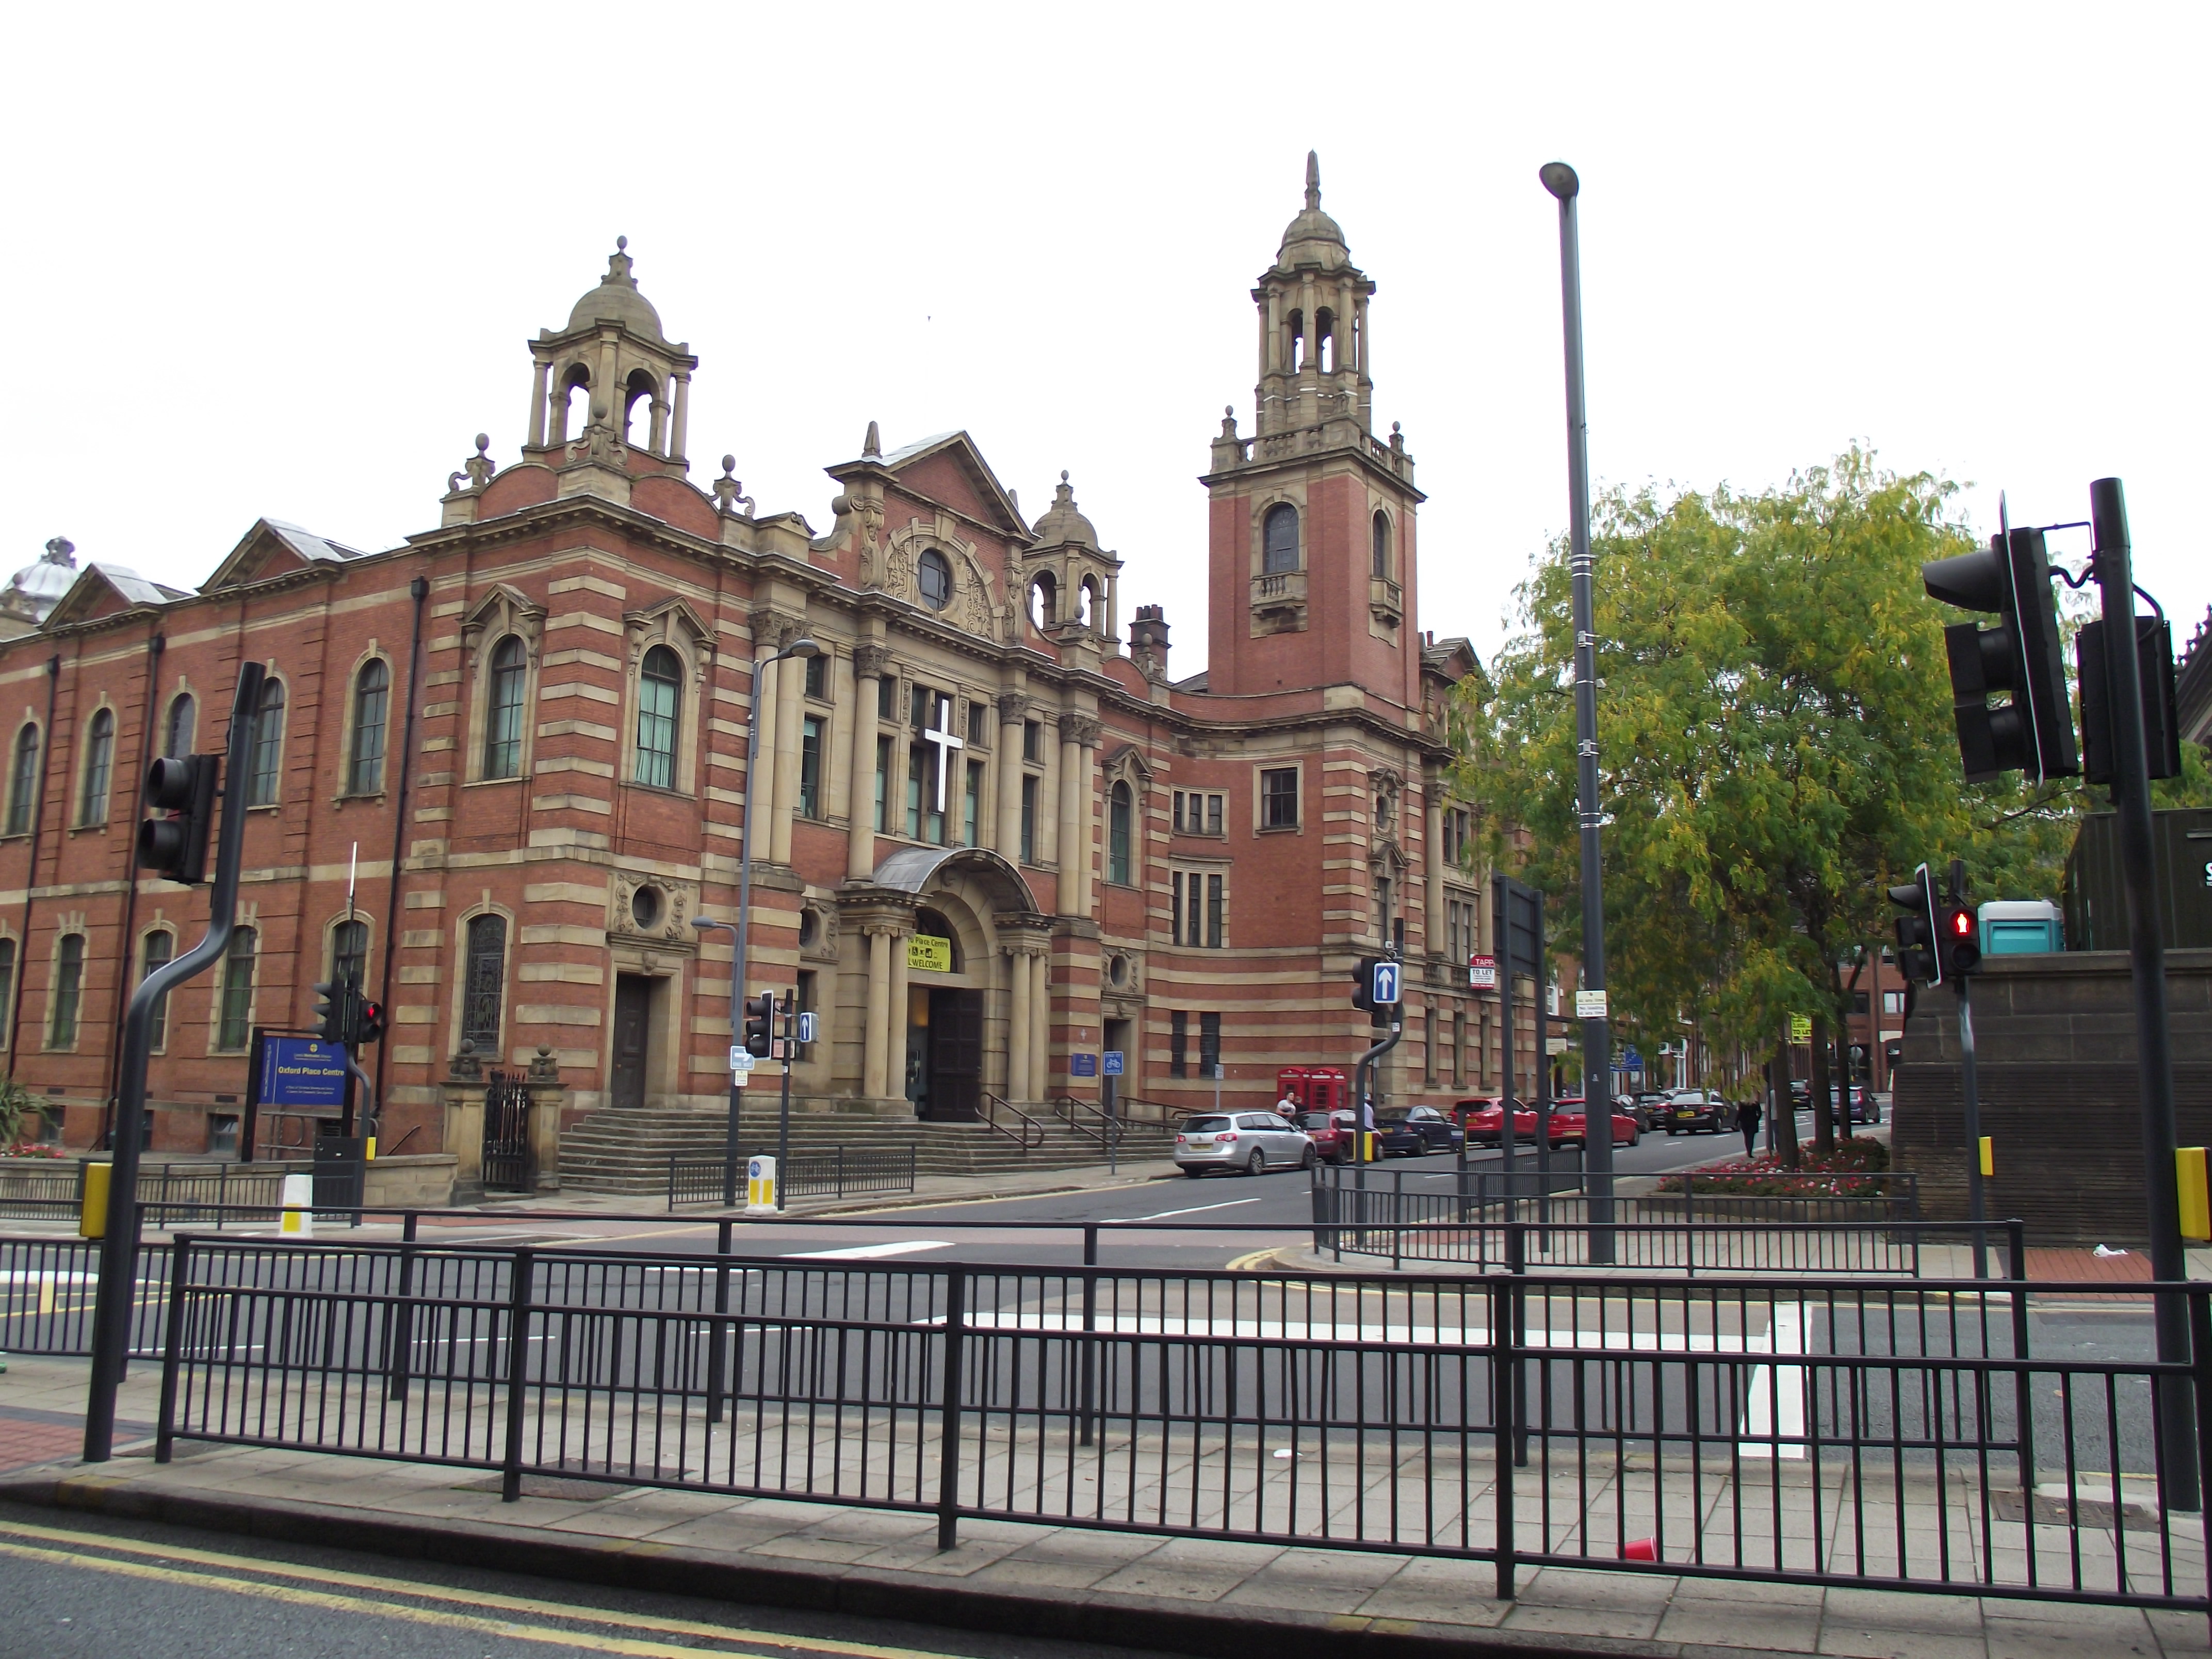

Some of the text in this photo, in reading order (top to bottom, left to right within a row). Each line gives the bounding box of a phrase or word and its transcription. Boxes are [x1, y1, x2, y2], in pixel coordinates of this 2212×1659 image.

[916, 936, 930, 946] Place
[931, 939, 949, 948] Centre
[912, 958, 943, 969] WELCOME
[278, 1066, 345, 1076] Oxford Place Centre
